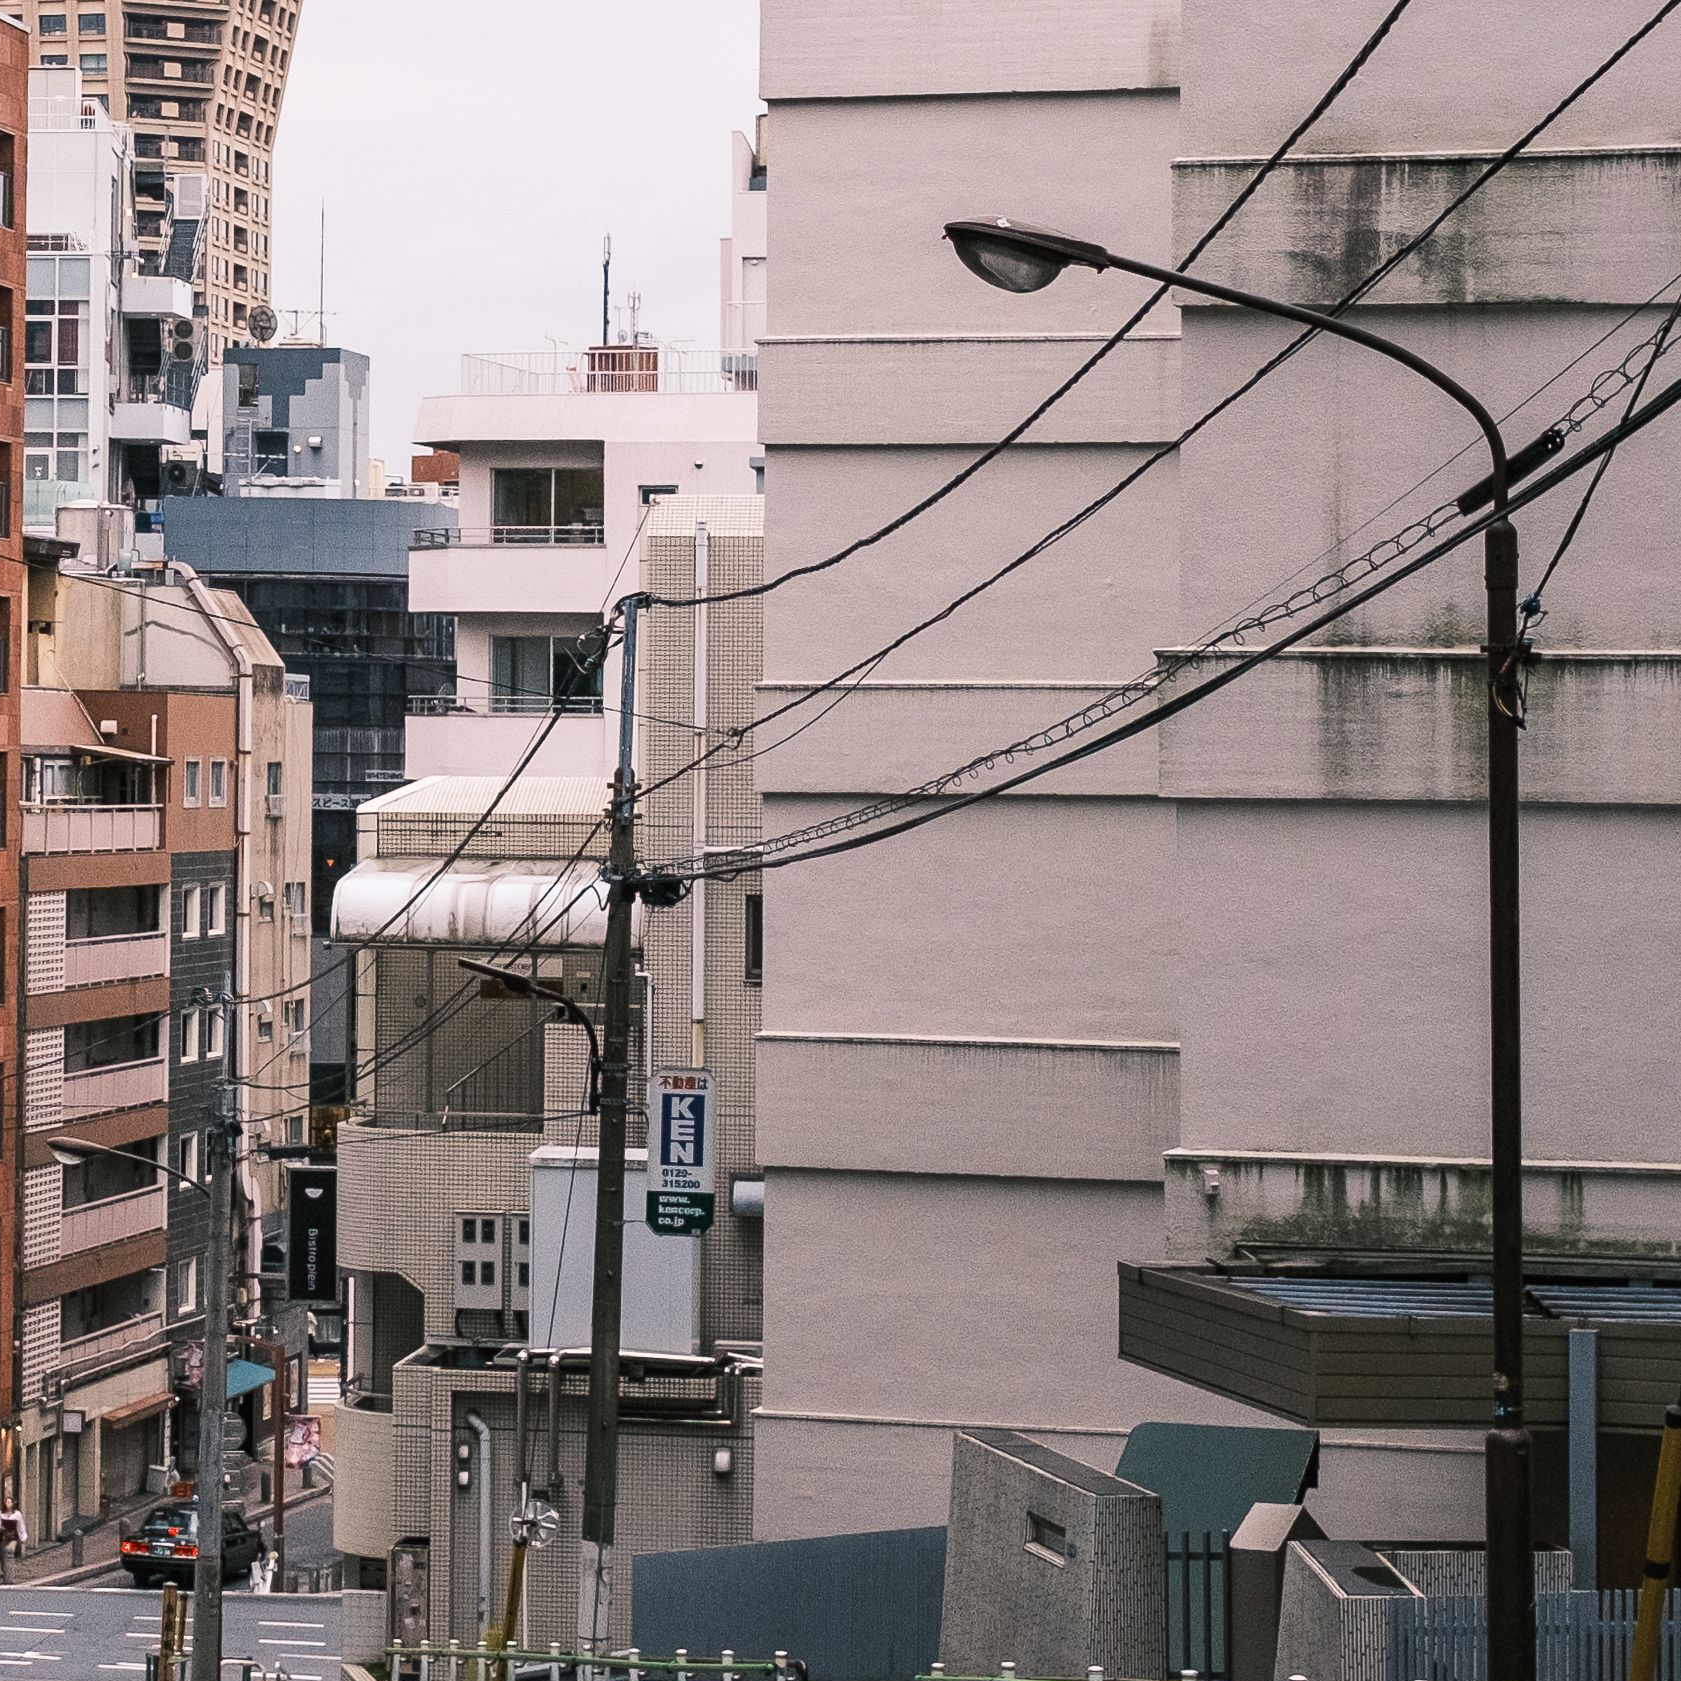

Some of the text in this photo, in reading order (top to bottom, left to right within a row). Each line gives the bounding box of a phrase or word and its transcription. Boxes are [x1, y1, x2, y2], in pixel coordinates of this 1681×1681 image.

[659, 1075, 709, 1090] 不動産は
[670, 1096, 695, 1164] KEN
[662, 1180, 701, 1189] 315200
[307, 1228, 319, 1262] Bistro
